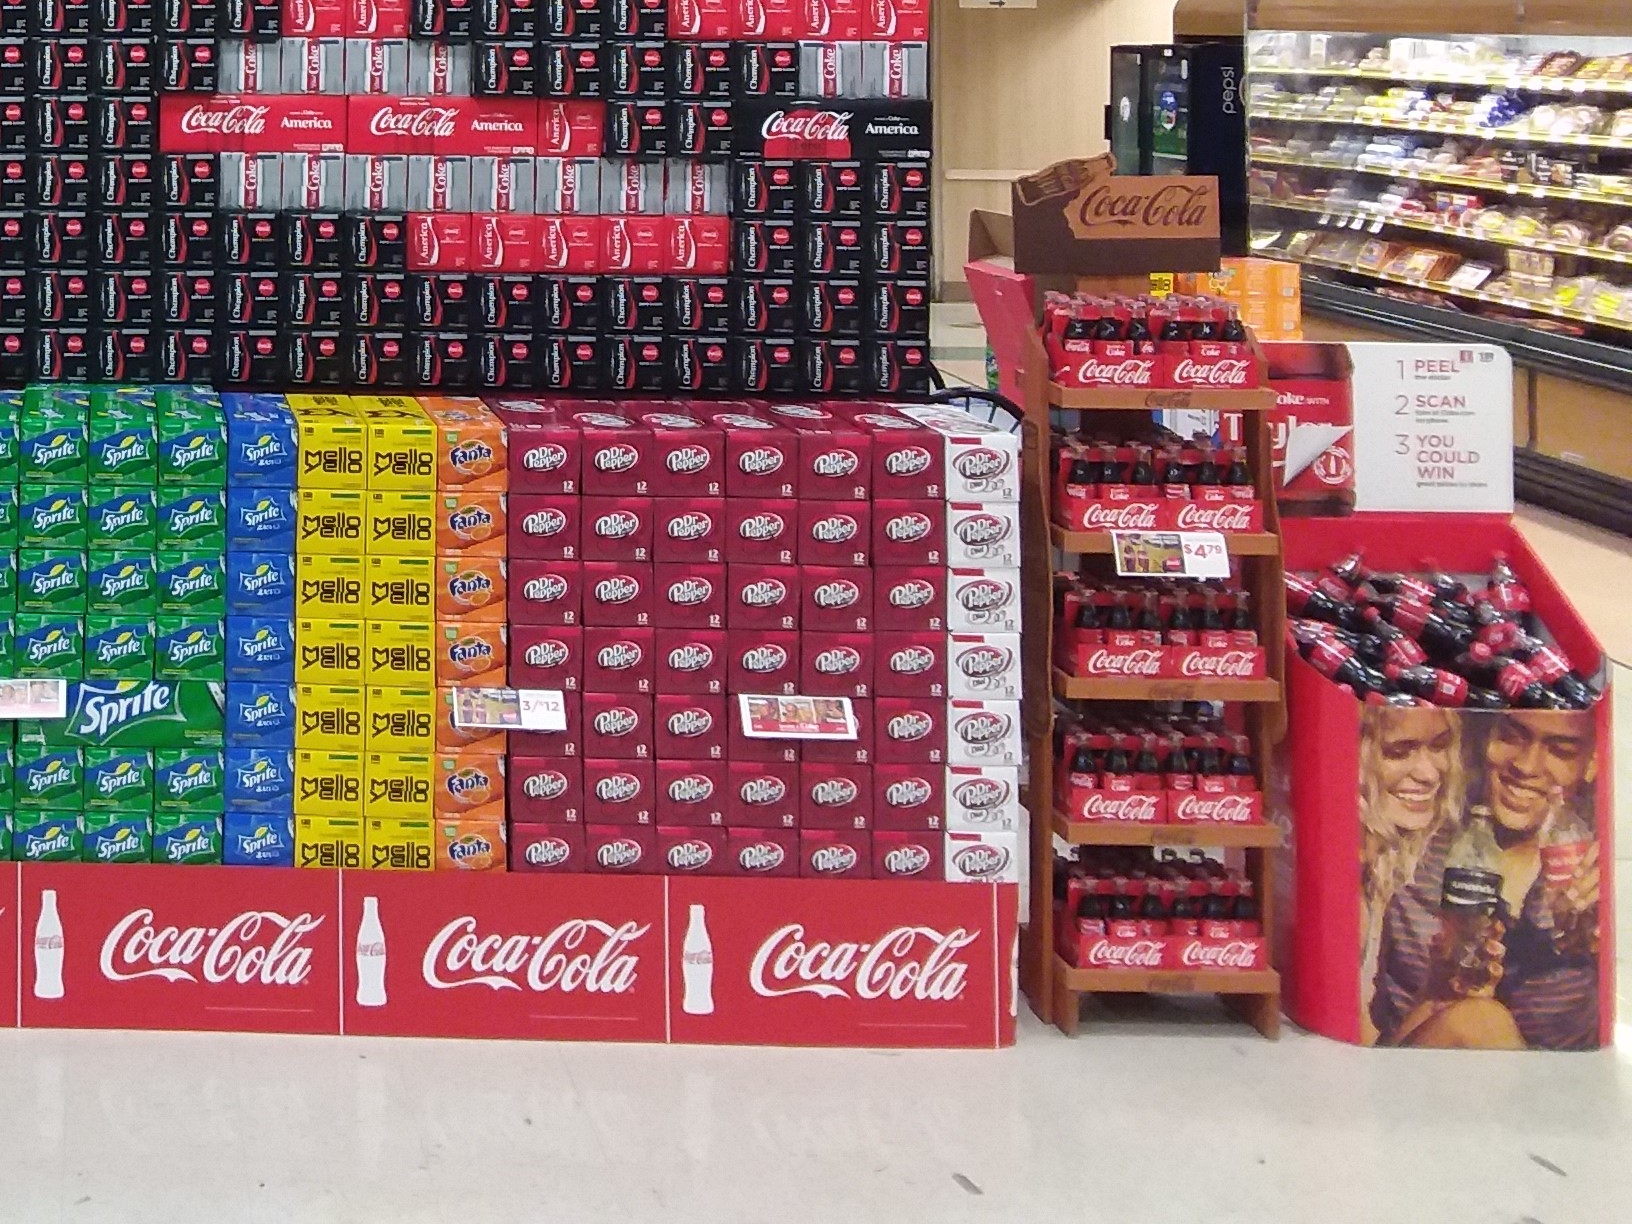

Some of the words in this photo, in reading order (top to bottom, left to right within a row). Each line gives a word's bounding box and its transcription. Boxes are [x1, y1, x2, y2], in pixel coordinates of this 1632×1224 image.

[181, 105, 270, 134] Coca-Cola
[281, 116, 332, 130] America
[370, 107, 460, 136] Coca-Cola
[471, 118, 523, 132] America
[761, 111, 854, 141] Coca-Cola
[865, 122, 919, 135] America
[1080, 184, 1209, 226] Coca-Cola
[1079, 358, 1154, 385] Coca-Cola
[1174, 359, 1250, 385] Coca-Cola
[1397, 360, 1404, 380] 1
[1415, 359, 1459, 373] PEEL
[1274, 392, 1305, 405] oke
[1395, 395, 1410, 415] 2
[1416, 395, 1466, 408] SCAN
[33, 443, 75, 465] Sprite
[103, 443, 145, 466] Sprite
[172, 444, 214, 467] Sprite
[245, 440, 281, 463] Sprite
[450, 446, 492, 465] Fanta
[538, 446, 554, 459] Dr
[610, 446, 626, 459] Dr
[755, 450, 770, 462] Dr
[1395, 434, 1410, 455] 3
[1417, 435, 1454, 448] YOU
[527, 451, 565, 469] Pepper
[598, 452, 636, 470] Pepper
[744, 455, 781, 473] Pepper
[1417, 451, 1480, 464] COULD
[1418, 467, 1454, 479] WIN
[563, 480, 574, 490] 12
[637, 481, 647, 490] 12
[449, 512, 491, 531] Fanta
[1083, 503, 1159, 528] Coca-Cola
[1178, 503, 1253, 529] Coca-Cola
[1088, 649, 1164, 675] Coca-Cola
[1182, 651, 1258, 677] Coca-Cola
[79, 680, 169, 735] Sprite
[448, 840, 492, 859] Fanta
[98, 908, 326, 986] Coca-Cola
[423, 914, 652, 995] Coca-Cola
[1090, 939, 1166, 966] Coca-Cola
[1182, 940, 1259, 967] Coca-Cola
[749, 923, 980, 1000] Coca-Cola
